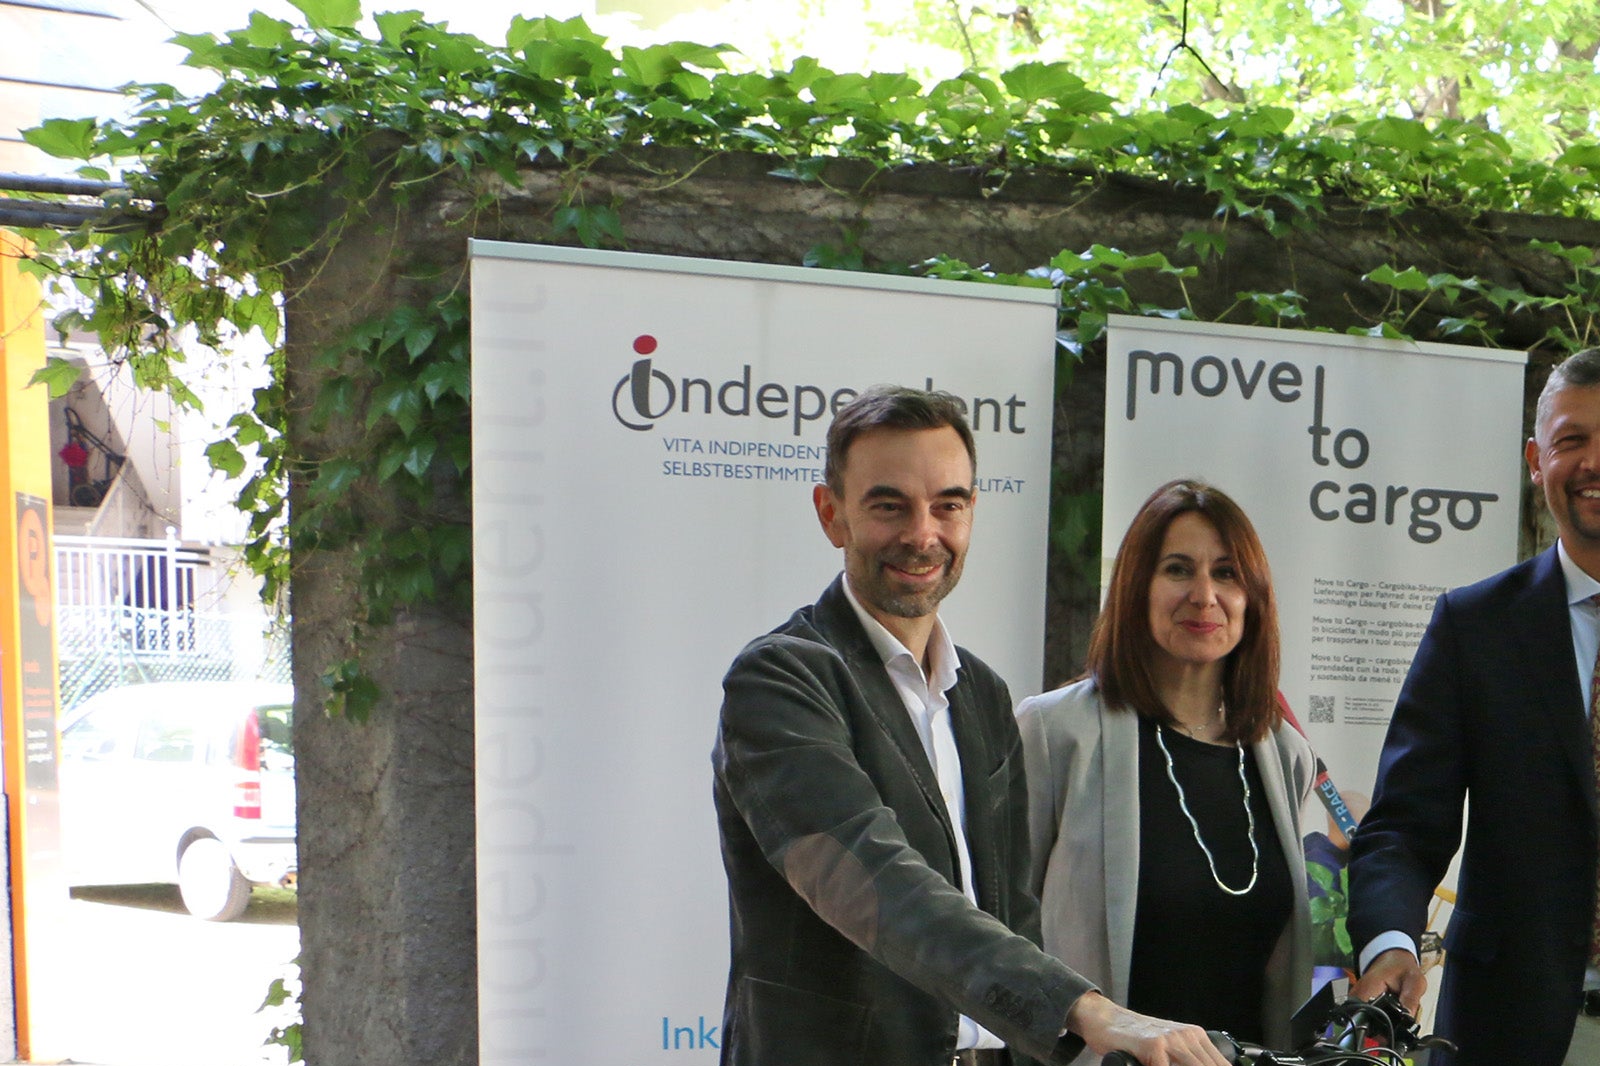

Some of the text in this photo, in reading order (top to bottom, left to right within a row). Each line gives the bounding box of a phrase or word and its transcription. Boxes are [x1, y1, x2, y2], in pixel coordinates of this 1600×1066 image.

[1126, 350, 1302, 421] move
[1308, 365, 1370, 468] to
[663, 438, 703, 454] VITA
[1309, 480, 1498, 544] cargo
[1314, 578, 1334, 586] Move
[1346, 580, 1369, 590] Cargo
[1314, 588, 1358, 598] Lieferungen
[1361, 591, 1373, 599] per
[1409, 593, 1420, 601] die
[1313, 597, 1357, 607] nachhaltige
[1360, 599, 1386, 610] Lösung
[1389, 601, 1400, 609] für
[1403, 602, 1422, 610] deine
[1313, 615, 1332, 624] Move
[1345, 617, 1367, 627] Cargo
[1312, 636, 1325, 644] per
[1327, 636, 1369, 645] trasportare
[1311, 653, 1330, 662] Move
[1343, 655, 1366, 665] Cargo
